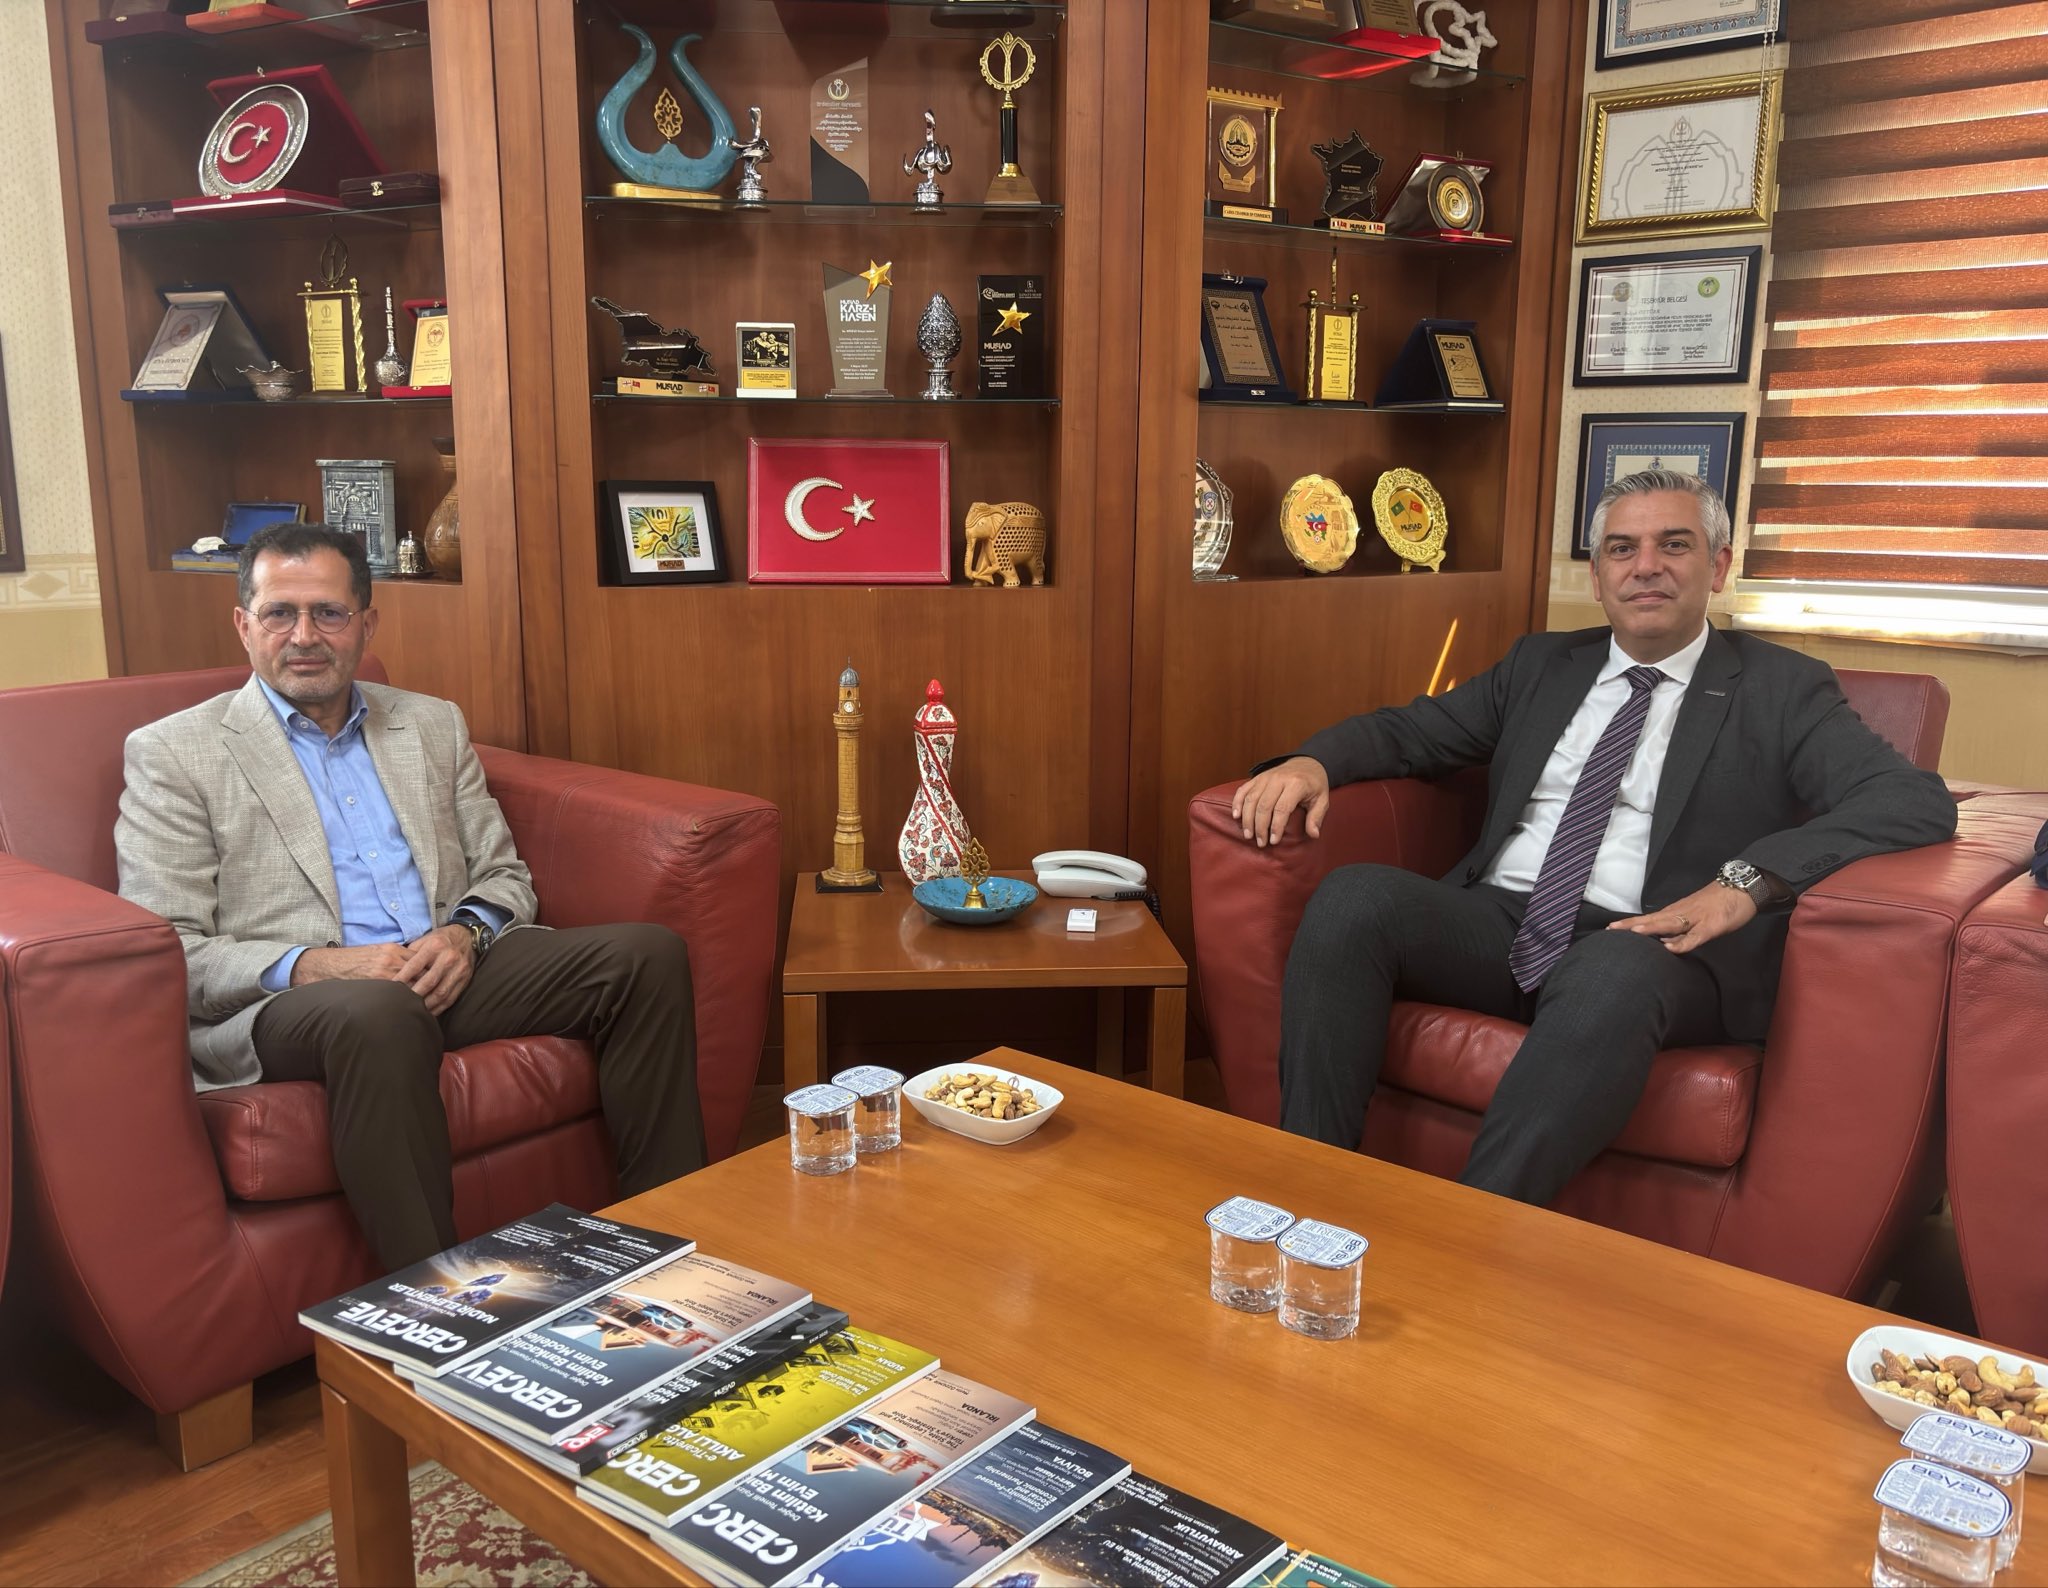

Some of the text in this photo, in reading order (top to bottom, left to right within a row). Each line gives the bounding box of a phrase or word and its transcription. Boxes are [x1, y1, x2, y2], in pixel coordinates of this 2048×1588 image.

[840, 313, 876, 322] HASEN
[385, 1282, 501, 1323] NADİR ELEMENTLER
[569, 1351, 609, 1370] Evim
[874, 1356, 907, 1371] SUDAN
[560, 1361, 615, 1386] Katılım
[877, 1411, 893, 1419] and
[890, 1410, 908, 1418] Role
[958, 1402, 1000, 1422] İRLANDA
[889, 1416, 928, 1434] Legitimacy
[904, 1416, 937, 1431] Strategic
[657, 1433, 719, 1463] e-Ticarette
[692, 1435, 747, 1461] AKILLI
[943, 1439, 960, 1448] The
[1049, 1455, 1094, 1477] BOLİVYA
[983, 1464, 1059, 1501] Economic Partnership
[1031, 1465, 1078, 1488] Karz-ı Hasen
[1068, 1473, 1086, 1481] Latin
[771, 1475, 820, 1499] Evim
[973, 1473, 1048, 1509] Community-Focused
[1012, 1485, 1053, 1505] Social and
[750, 1494, 780, 1509] Temelli
[765, 1488, 830, 1522] Katılım
[1135, 1492, 1158, 1507] Küresel
[774, 1505, 804, 1521] Değer
[1158, 1503, 1193, 1523] BAYRAKTAR
[1170, 1521, 1245, 1560] ARNAVUTLUK
[1119, 1548, 1146, 1562] Made
[1120, 1555, 1169, 1581] Ekonomi ve
[1140, 1558, 1175, 1577] Kalkanı
[1190, 1558, 1222, 1575] Genomik
